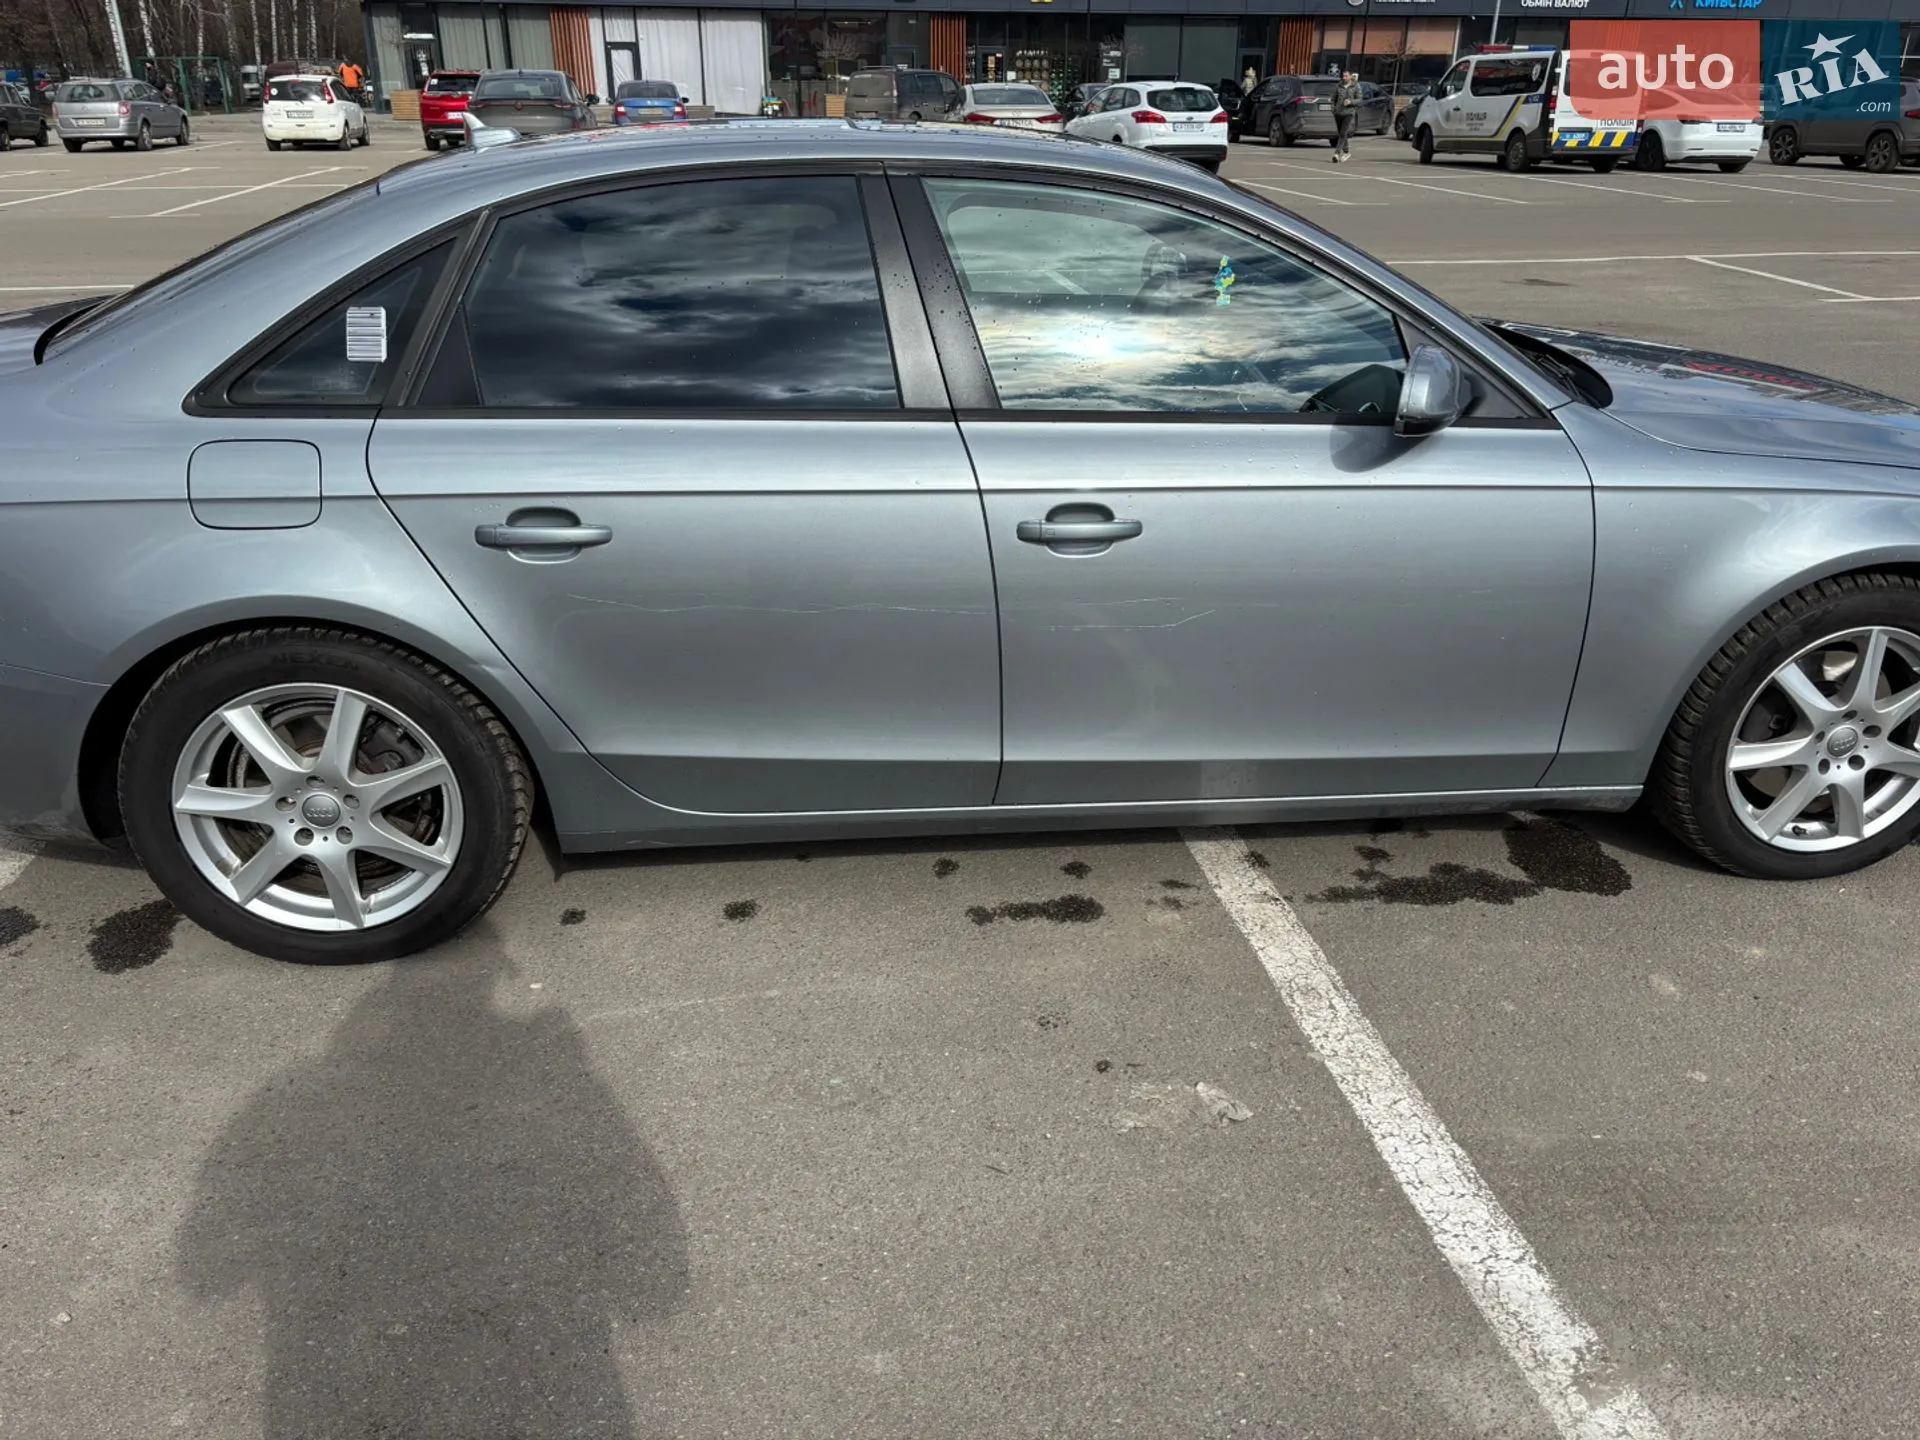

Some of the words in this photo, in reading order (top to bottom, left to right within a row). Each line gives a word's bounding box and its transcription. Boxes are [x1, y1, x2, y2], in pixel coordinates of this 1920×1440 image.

[1521, 0, 1552, 8] ОБМІН
[1554, 0, 1590, 8] ВАЛЮТ
[1600, 118, 1635, 127] ПОЛІЦІЯ
